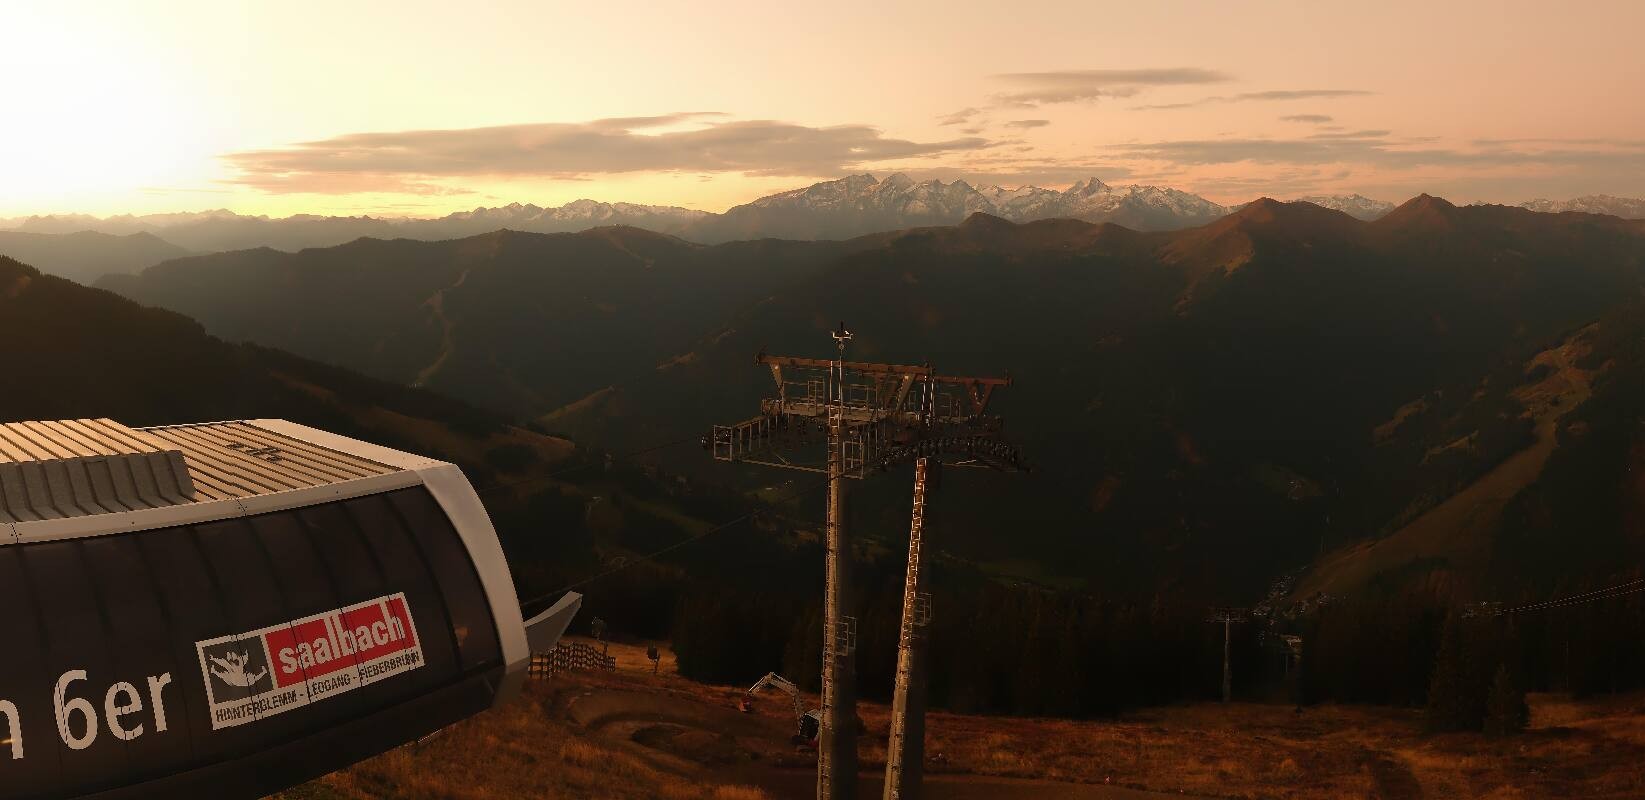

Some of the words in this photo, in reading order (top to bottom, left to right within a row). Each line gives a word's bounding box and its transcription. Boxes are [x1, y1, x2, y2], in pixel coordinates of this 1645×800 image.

[278, 601, 406, 675] saalbach
[53, 669, 172, 750] 6er
[307, 673, 351, 697] LEOGANG
